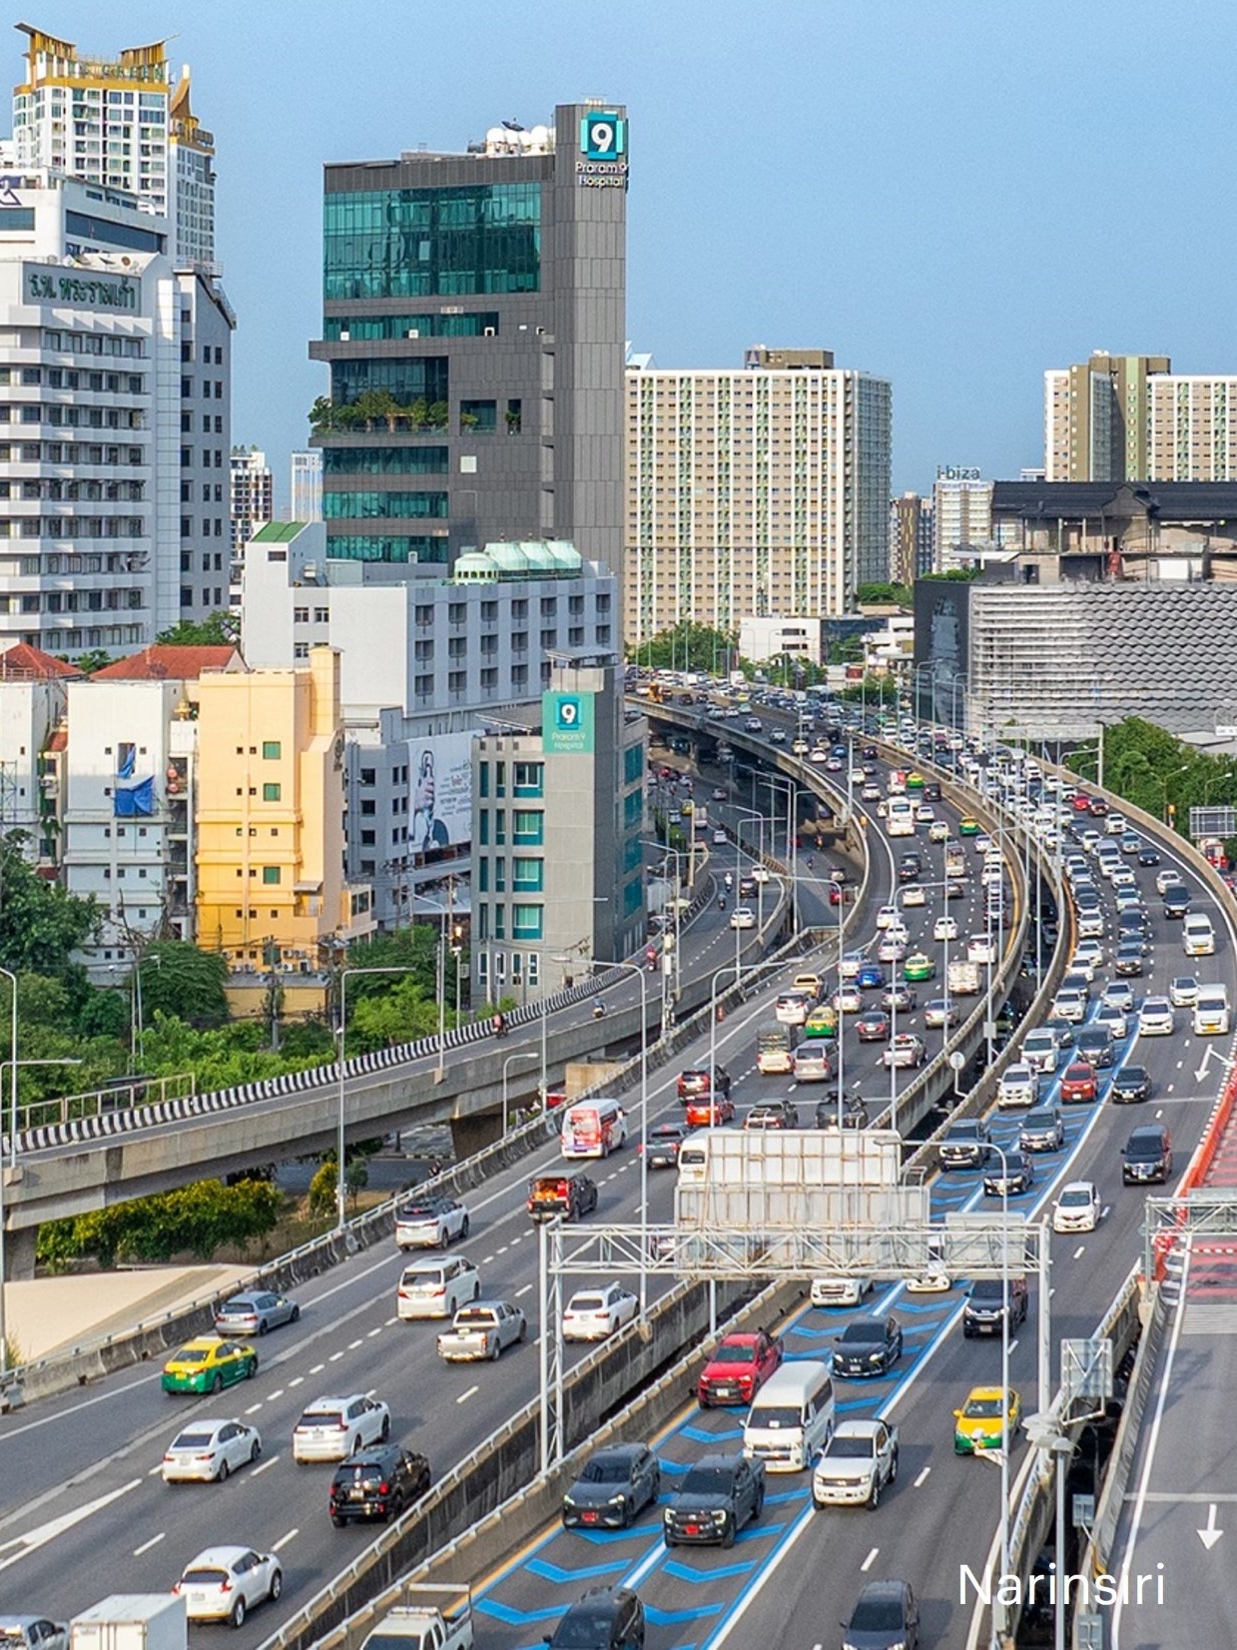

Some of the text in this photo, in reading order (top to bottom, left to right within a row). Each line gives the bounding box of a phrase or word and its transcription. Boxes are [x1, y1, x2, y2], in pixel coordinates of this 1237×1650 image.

[590, 122, 613, 153] 9
[578, 175, 624, 190] Hospital
[937, 464, 980, 480] i-biza
[561, 703, 576, 725] 9
